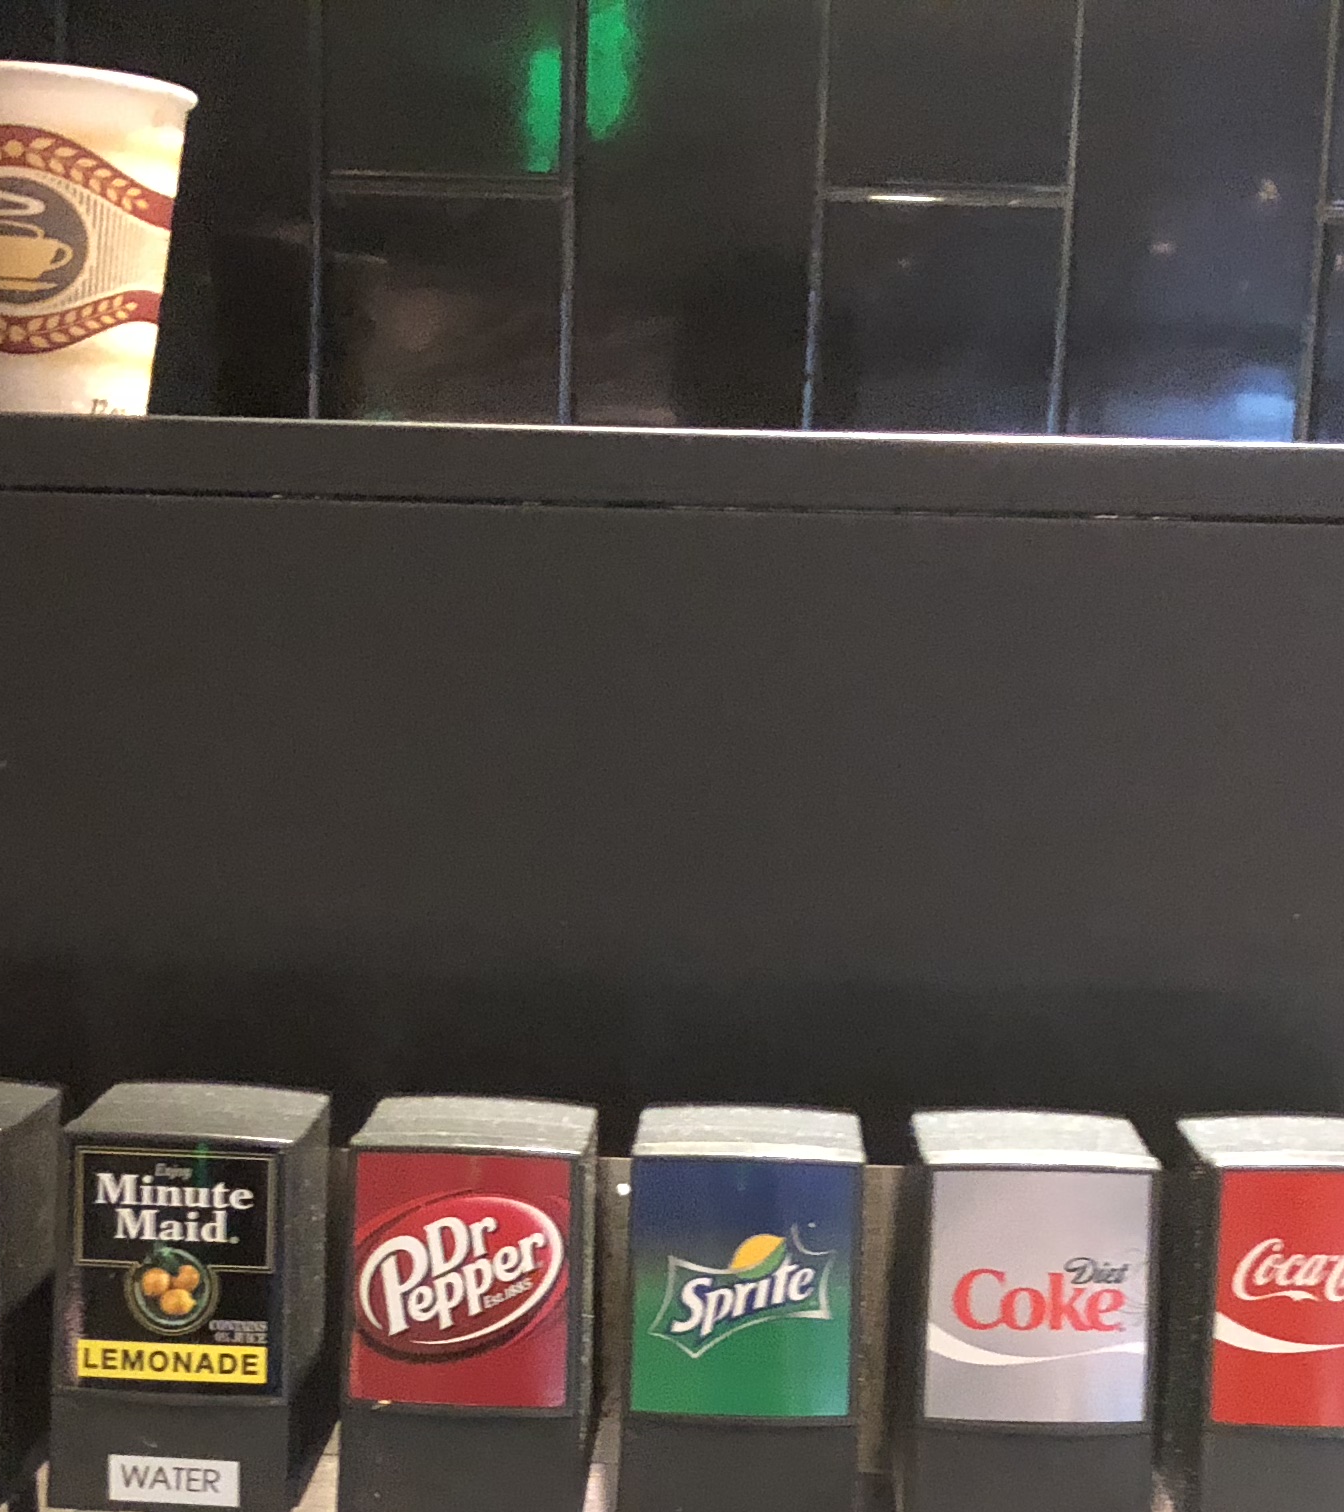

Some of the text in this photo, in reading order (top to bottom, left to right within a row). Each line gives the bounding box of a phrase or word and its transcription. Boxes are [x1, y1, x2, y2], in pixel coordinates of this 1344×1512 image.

[94, 1172, 255, 1210] Minute
[423, 1216, 498, 1278] Dr
[1063, 1256, 1130, 1285] Diet
[360, 1232, 546, 1337] Pepper
[670, 1252, 817, 1337] Sprite
[952, 1267, 1127, 1332] Coke
[83, 1347, 260, 1377] LEMONADE
[120, 1463, 222, 1494] WATER
